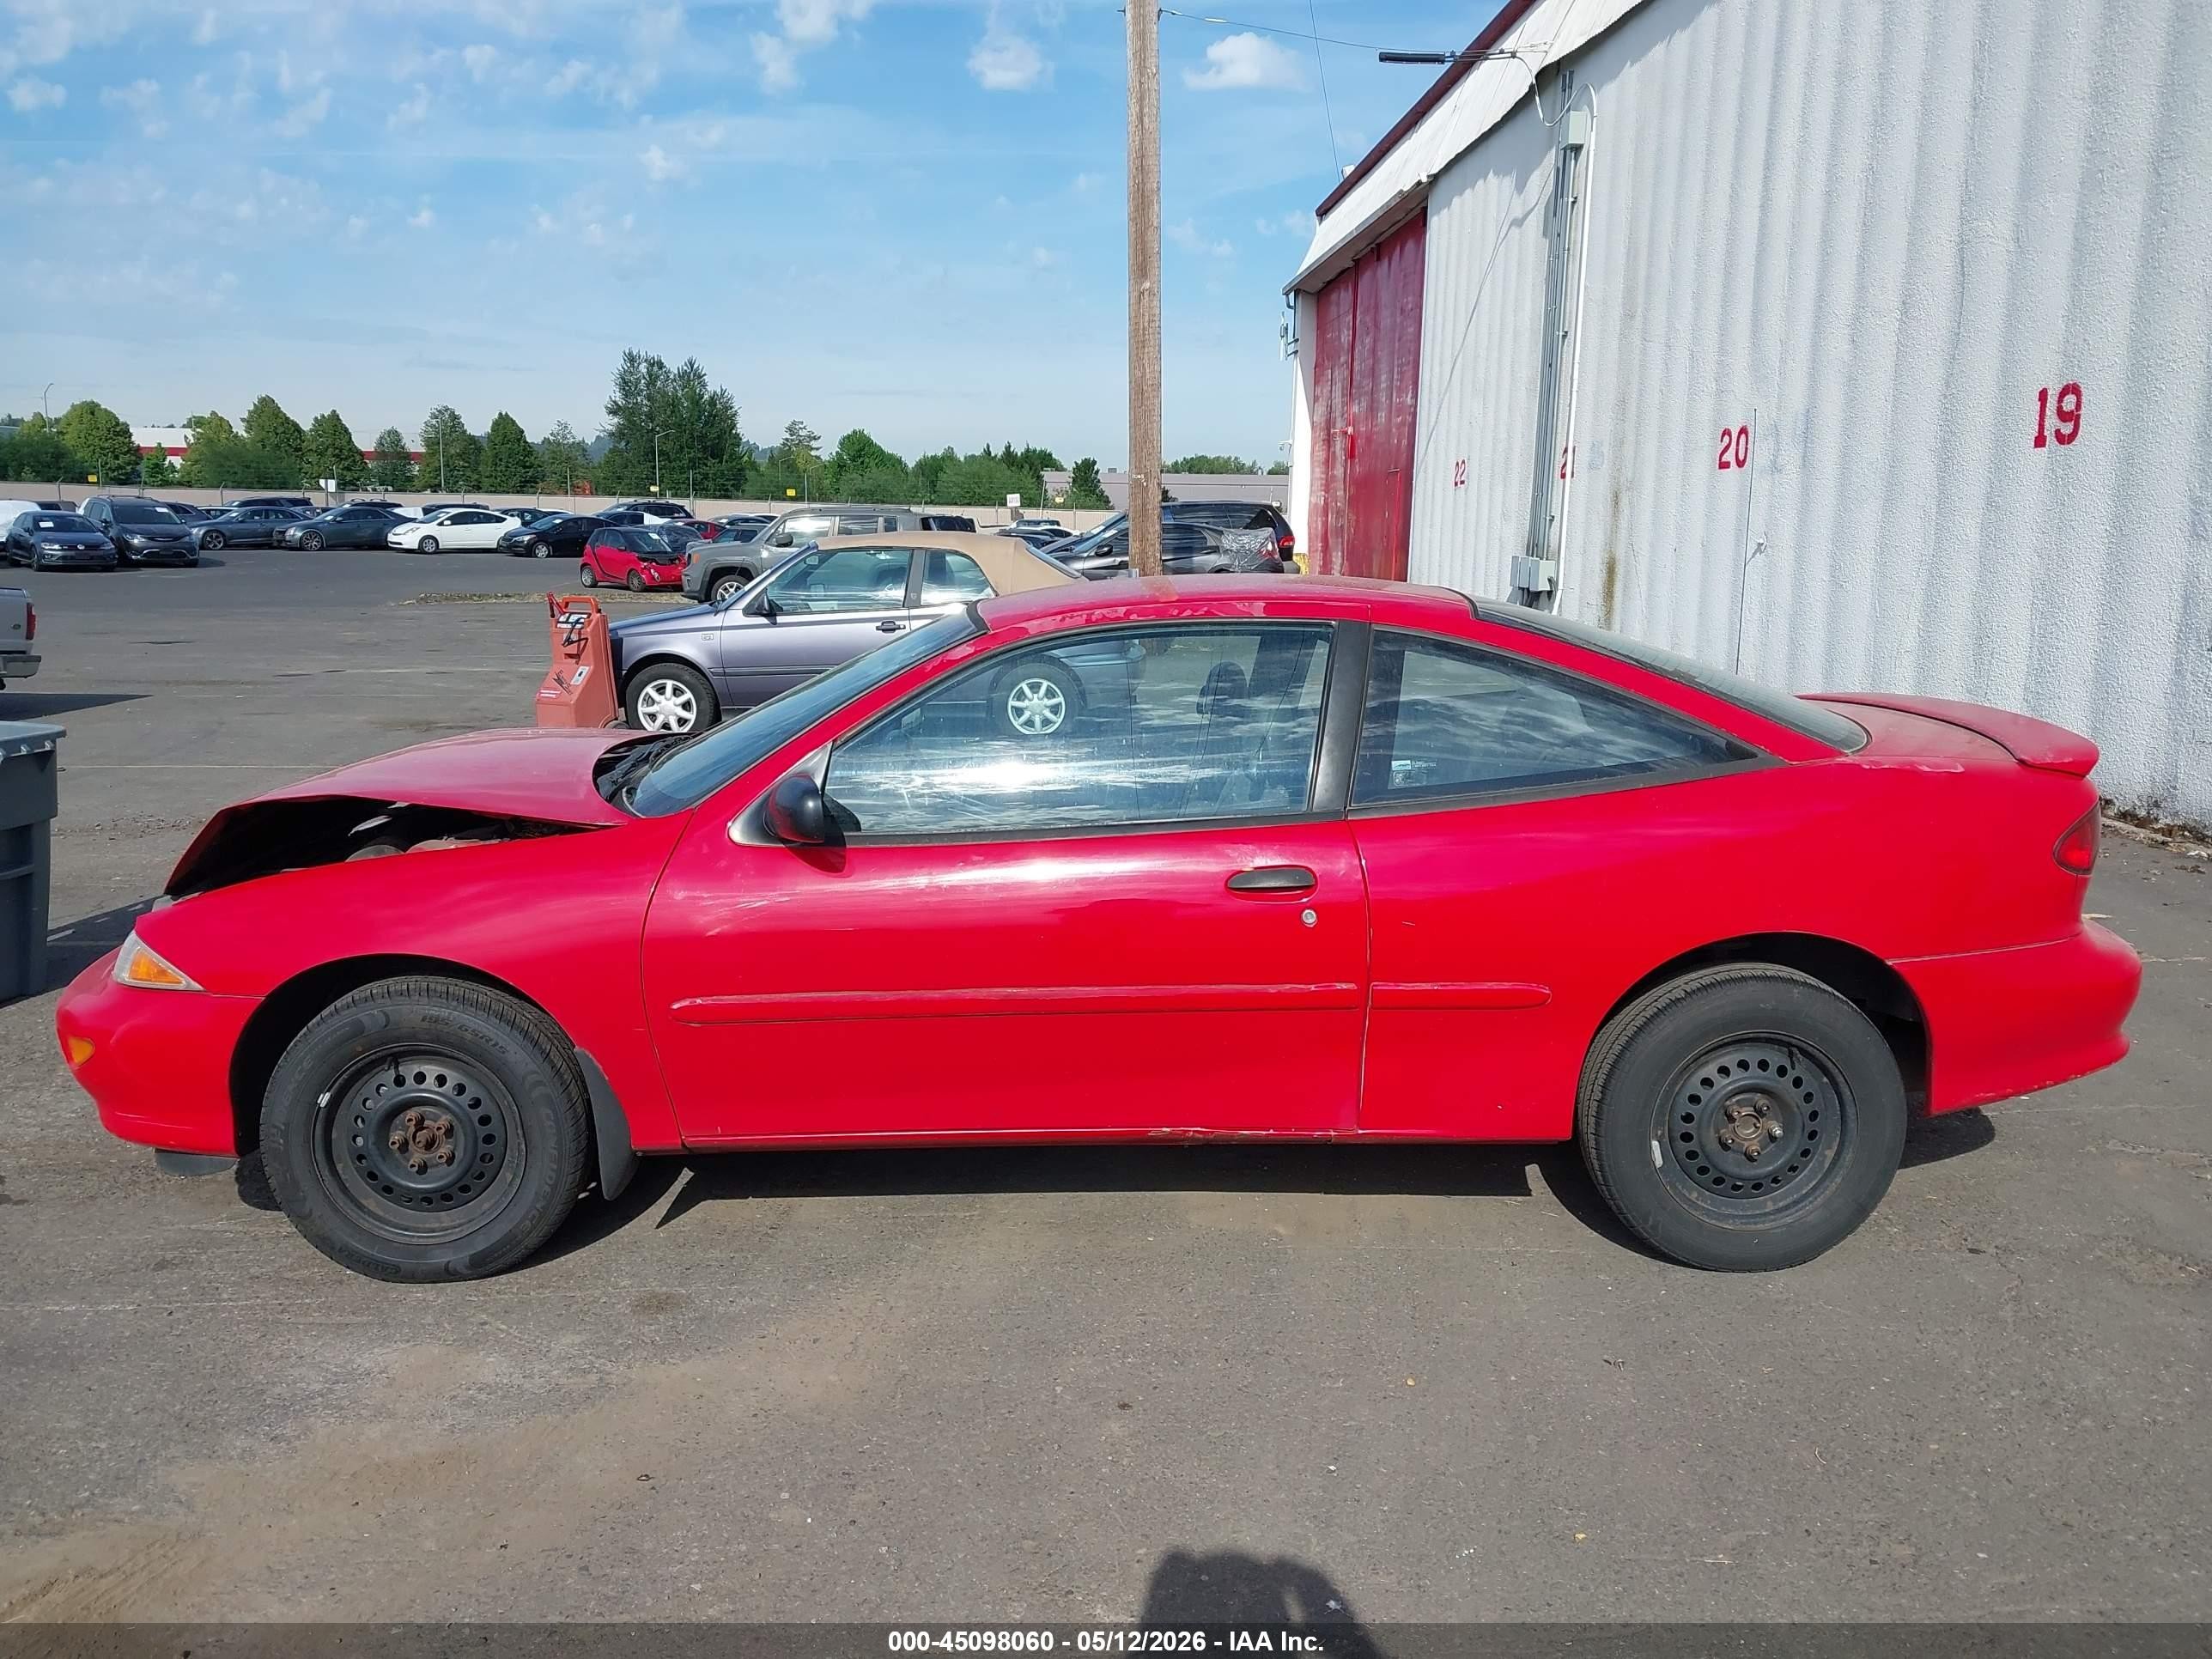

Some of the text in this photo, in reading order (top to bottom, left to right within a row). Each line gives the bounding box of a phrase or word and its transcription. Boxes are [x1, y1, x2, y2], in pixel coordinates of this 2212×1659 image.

[2033, 382, 2081, 448] 19
[1718, 425, 1749, 470] 20
[1454, 459, 1467, 487] 22
